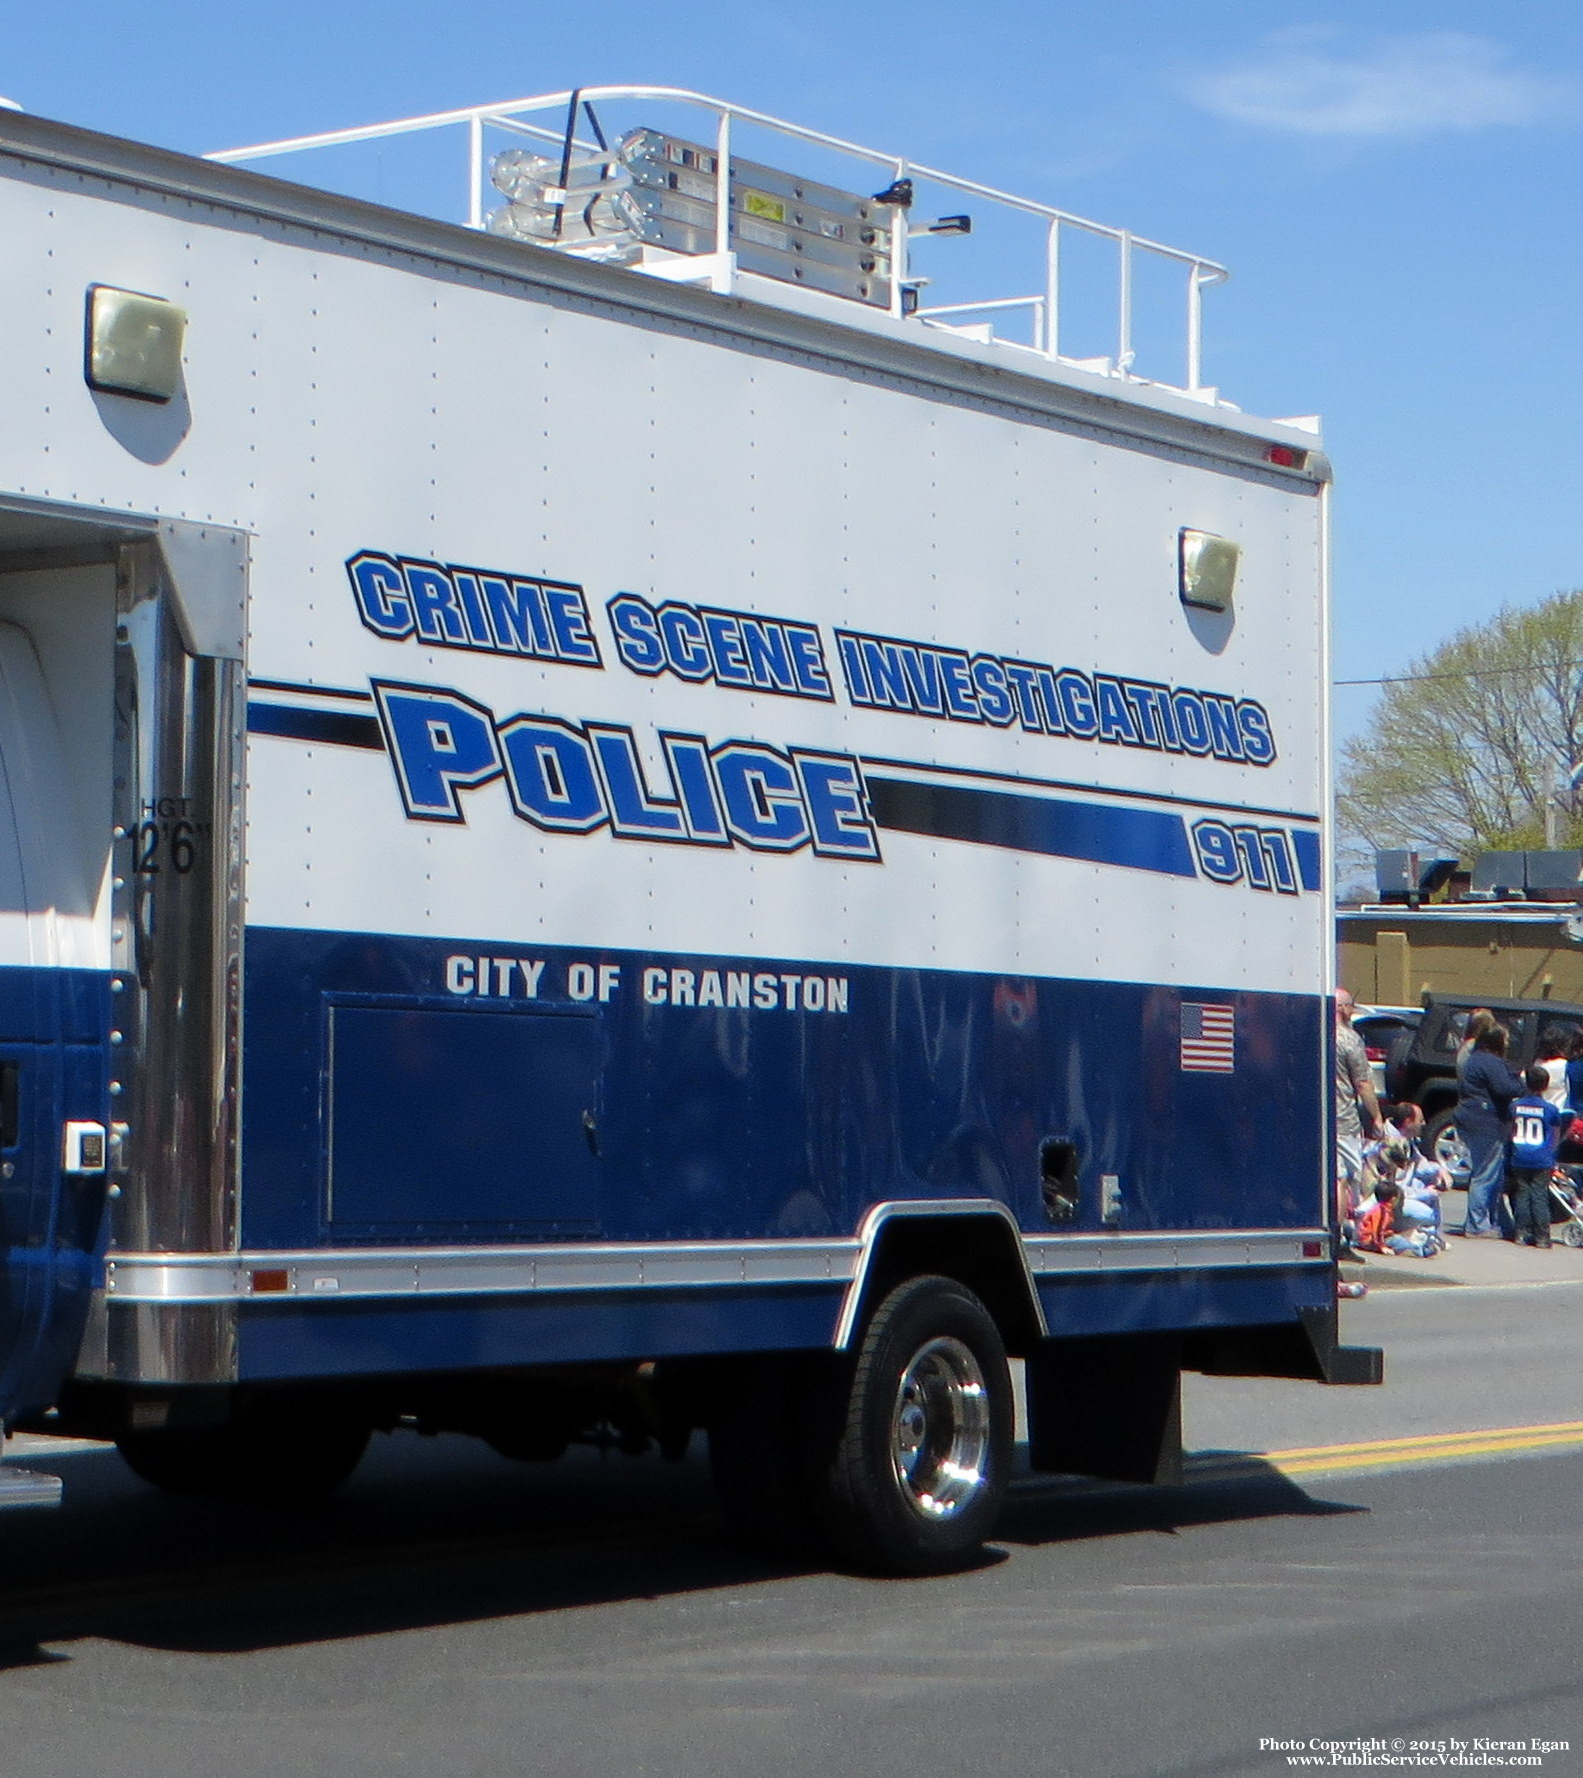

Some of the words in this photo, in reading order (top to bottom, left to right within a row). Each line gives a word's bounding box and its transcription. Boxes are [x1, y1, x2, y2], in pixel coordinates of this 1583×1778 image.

[346, 549, 604, 669] CRIME
[606, 592, 836, 702] SCENE
[833, 627, 1277, 767] INVESTIGATIONS
[369, 674, 884, 864] POLICE
[141, 798, 192, 818] HGT
[1192, 819, 1300, 896] 911
[445, 955, 545, 998] CITY
[567, 962, 621, 1002] OF
[643, 967, 848, 1013] CRANSTON
[1512, 1116, 1544, 1146] 10
